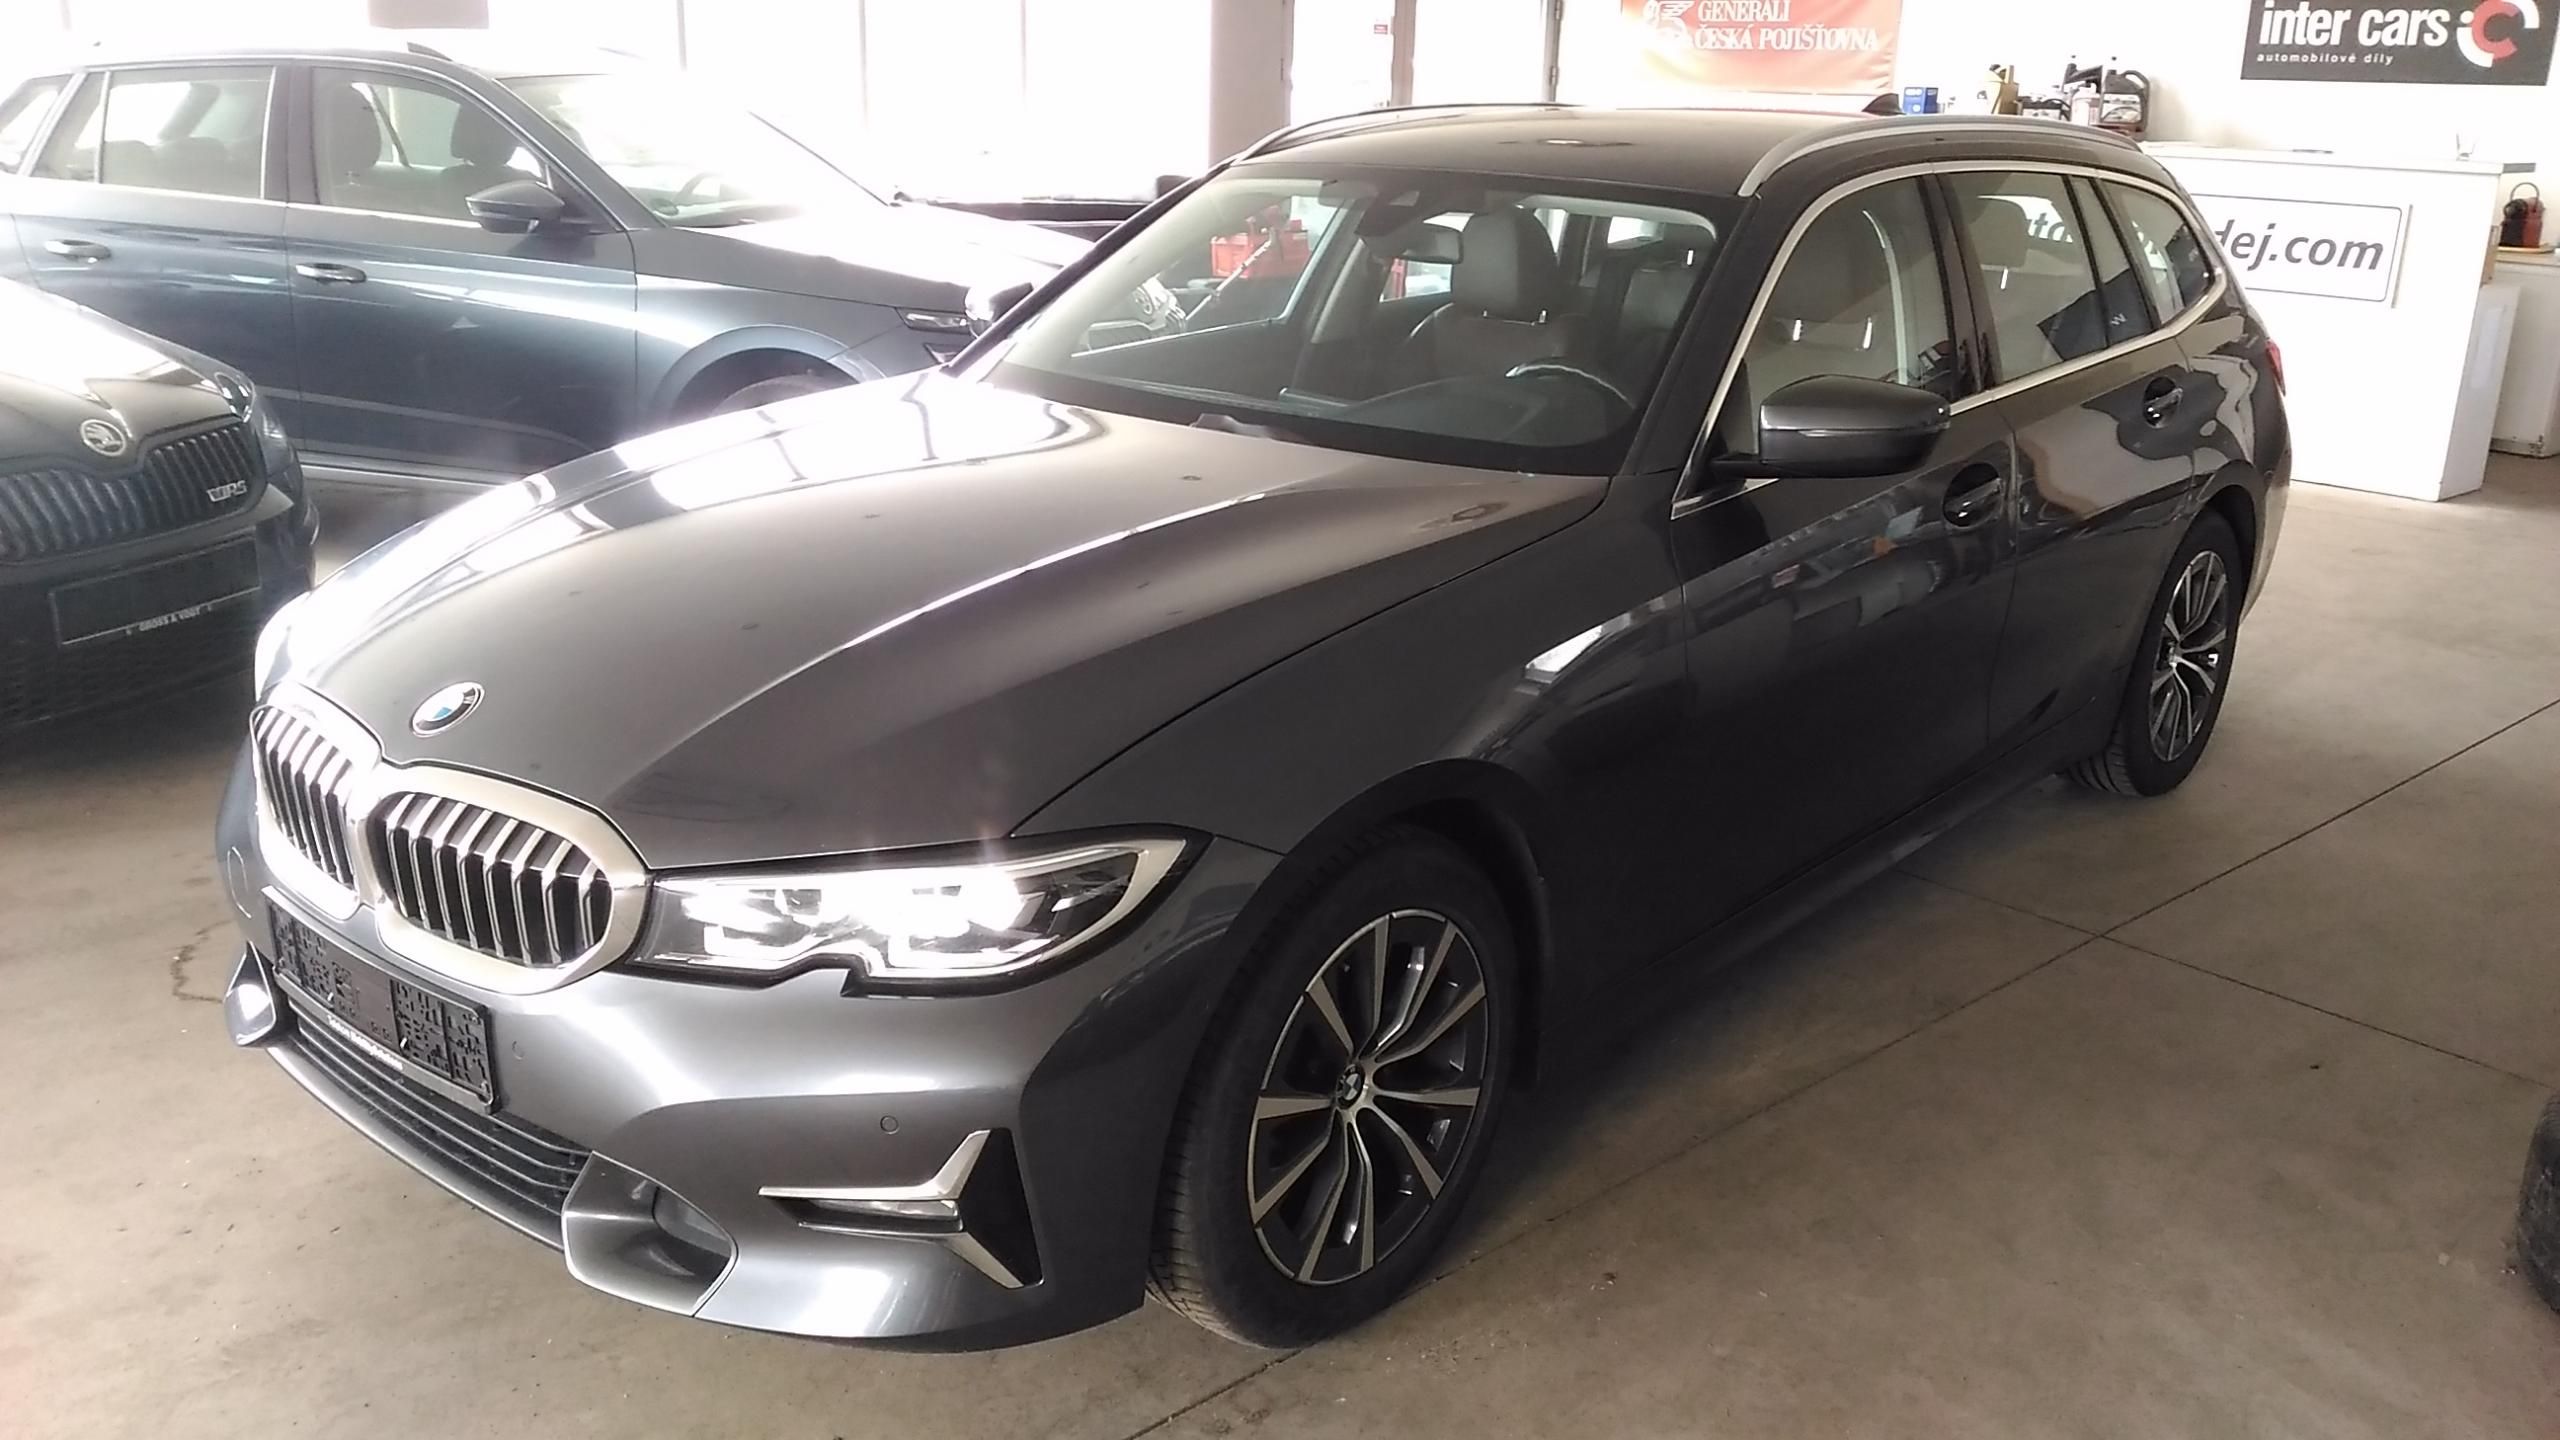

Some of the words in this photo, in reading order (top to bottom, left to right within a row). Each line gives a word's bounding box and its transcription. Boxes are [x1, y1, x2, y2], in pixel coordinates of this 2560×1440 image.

[1697, 0, 1790, 22] GENERALI
[2258, 0, 2351, 46] inter
[2357, 8, 2450, 47] cars
[1694, 23, 1754, 50] ČESKÁ
[1758, 24, 1880, 51] POJIŠŤOVNA
